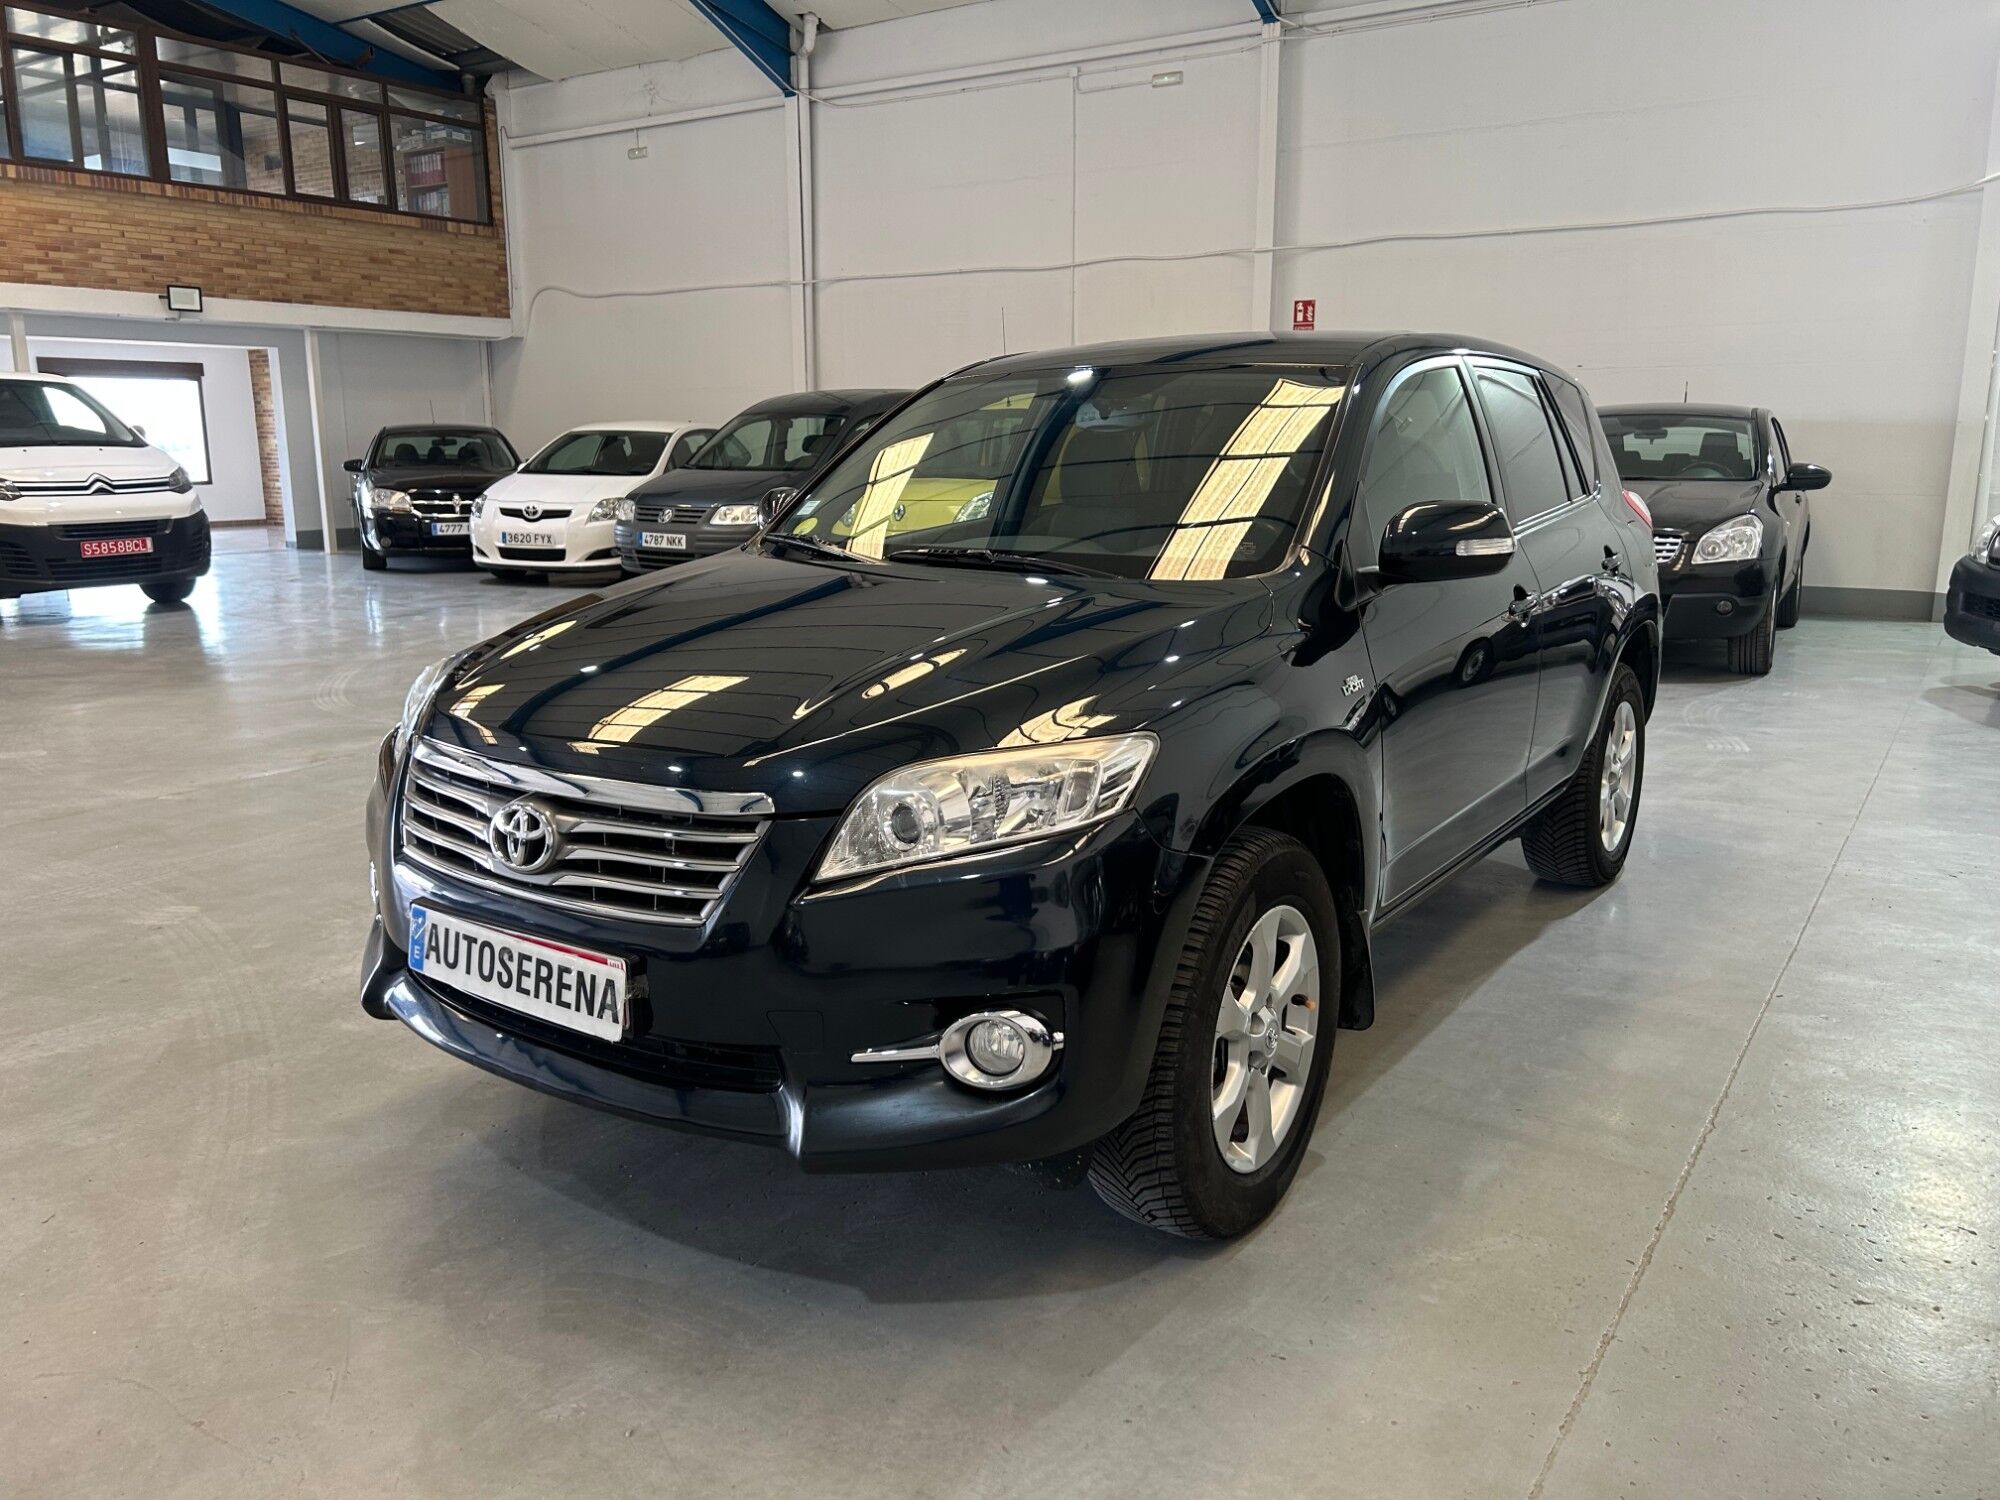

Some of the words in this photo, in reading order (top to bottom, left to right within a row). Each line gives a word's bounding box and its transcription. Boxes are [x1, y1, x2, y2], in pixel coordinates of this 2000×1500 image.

[440, 524, 463, 534] 4777
[508, 533, 532, 544] 3620
[534, 533, 553, 545] FYX
[644, 534, 665, 546] 4787
[666, 535, 684, 547] NKK
[84, 539, 147, 555] S5858BCL
[413, 945, 420, 959] E
[425, 922, 620, 1025] AUTOSERENA
